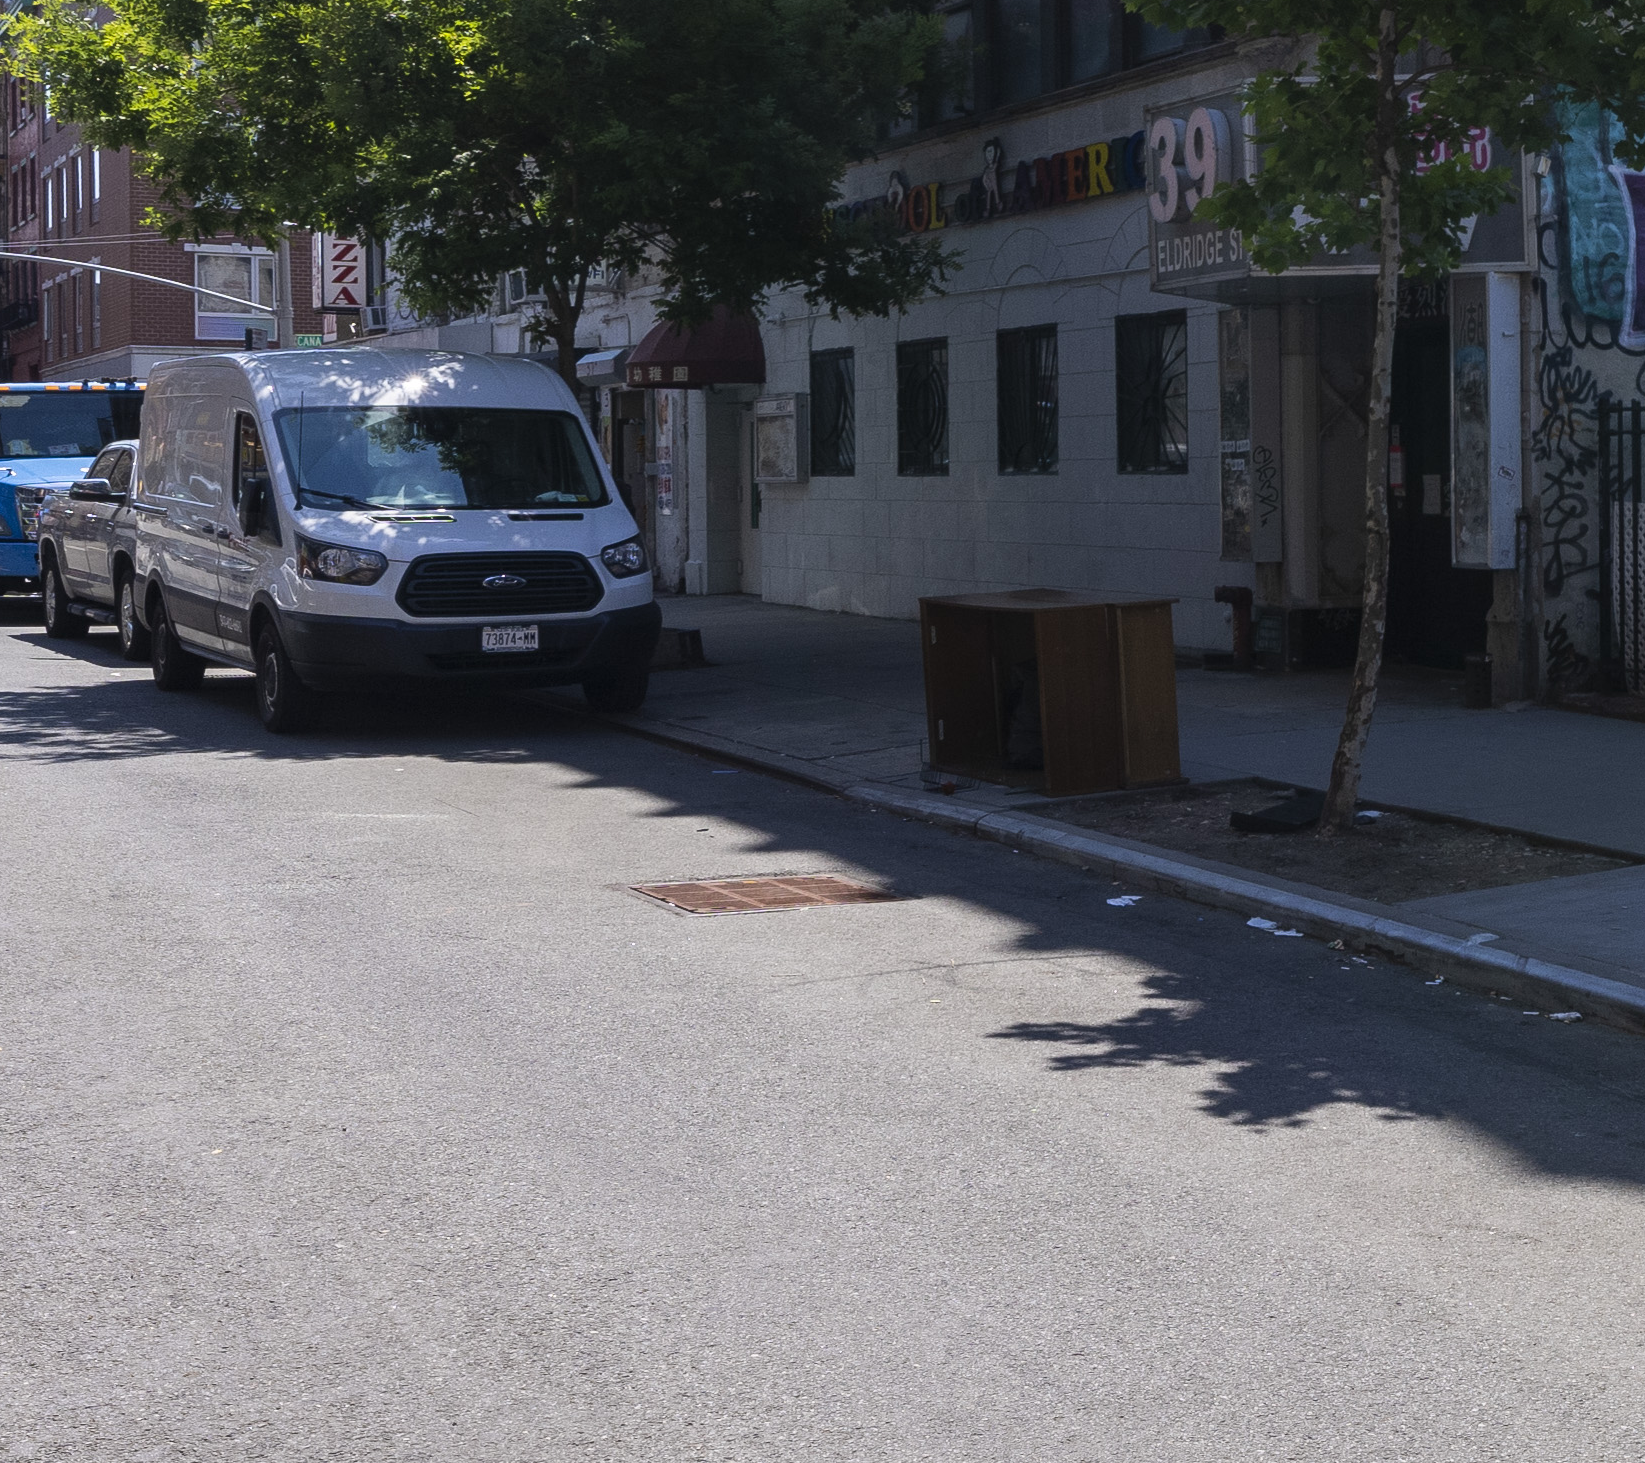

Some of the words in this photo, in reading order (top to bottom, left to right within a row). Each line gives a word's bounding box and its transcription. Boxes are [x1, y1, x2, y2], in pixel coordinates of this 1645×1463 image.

[1149, 106, 1222, 223] 39
[328, 235, 362, 306] ZZA
[1157, 231, 1224, 274] ELDRIDGE
